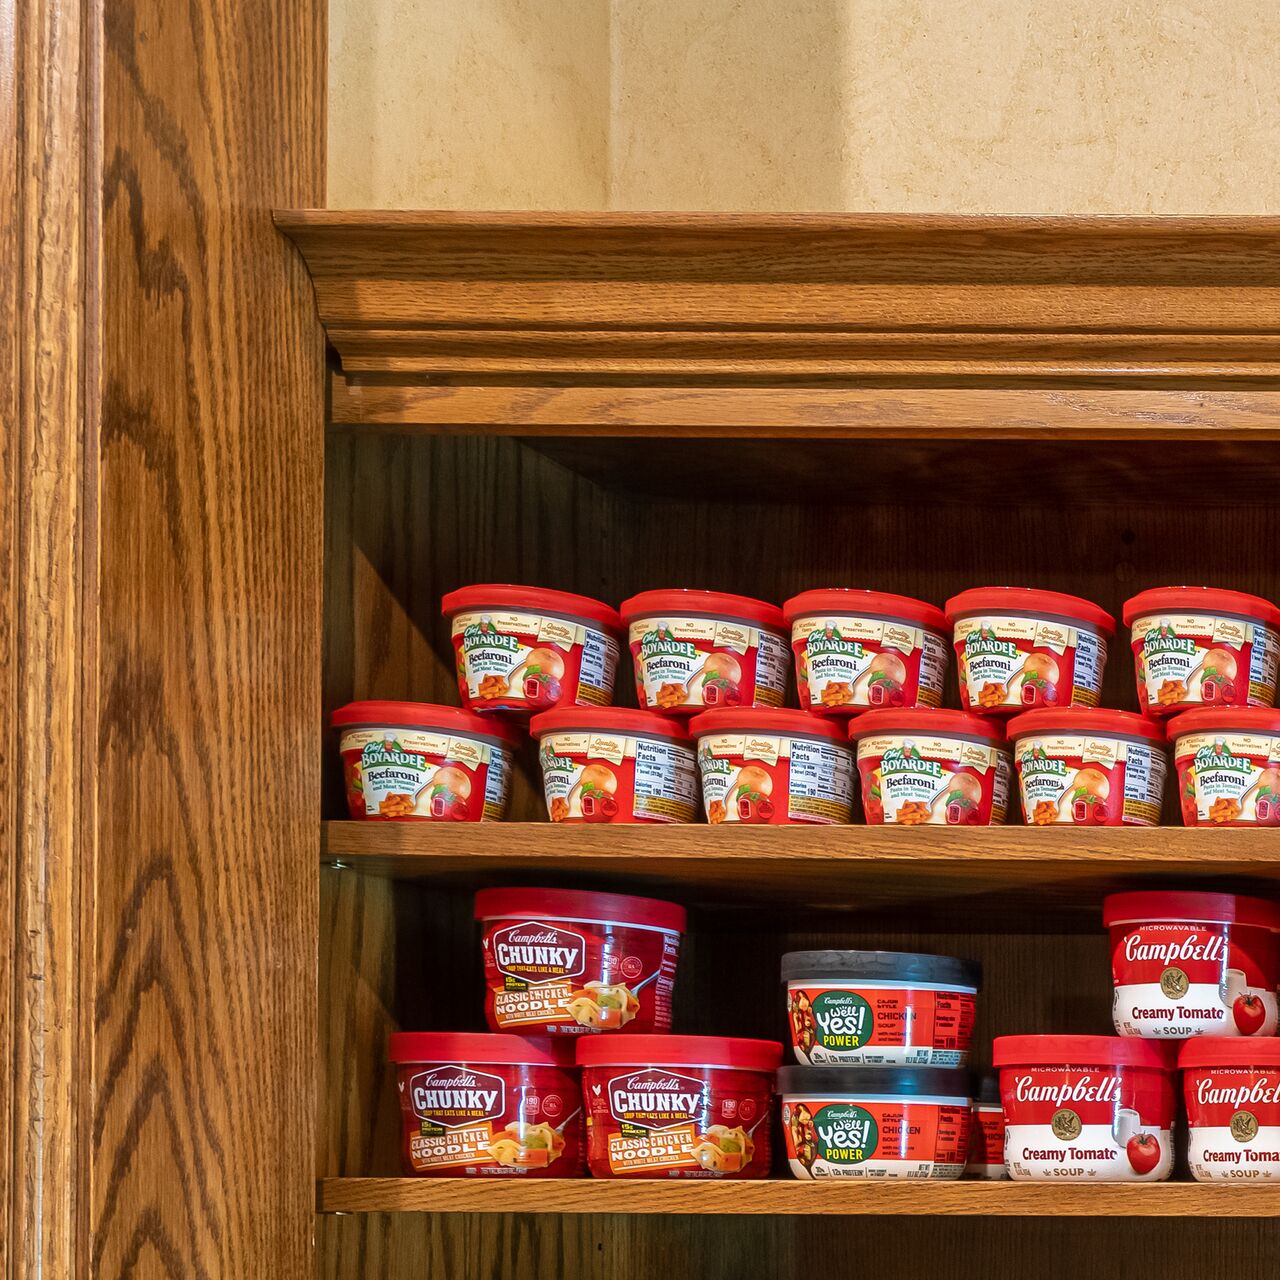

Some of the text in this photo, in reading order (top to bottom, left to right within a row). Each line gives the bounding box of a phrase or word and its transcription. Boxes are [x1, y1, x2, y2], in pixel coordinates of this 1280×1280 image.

[465, 625, 479, 636] Chef
[464, 634, 518, 650] BOYARDEE
[1144, 638, 1196, 656] BOYARDEE
[469, 652, 513, 666] Beefaroni
[1149, 654, 1190, 670] Beefaroni
[361, 751, 426, 769] BOYARDEE
[880, 759, 942, 777] BOYARDEE
[1194, 756, 1251, 773] BOYARDEE
[367, 768, 420, 784] Beefaroni
[886, 776, 935, 789] Beefaroni
[1200, 772, 1245, 786] Beefaroni
[831, 1006, 859, 1017] well
[1132, 1006, 1224, 1021] Creamy Tomato
[817, 1007, 865, 1034] Yes!
[1163, 1027, 1192, 1035] SOUP
[824, 1036, 859, 1046] POWER
[426, 1073, 476, 1089] Campbell's
[414, 1088, 497, 1110] CHUNKY
[1015, 1076, 1123, 1106] Campbell's
[834, 1119, 863, 1131] well
[412, 1132, 489, 1149] CLASSIC CHICKEN
[819, 1120, 869, 1149] Yes!
[412, 1142, 488, 1160] NOODLE
[826, 1149, 863, 1160] POWER
[1023, 1148, 1118, 1162] Creamy Tomato
[1203, 1150, 1242, 1163] Creamy
[1054, 1168, 1084, 1177] SOUP
